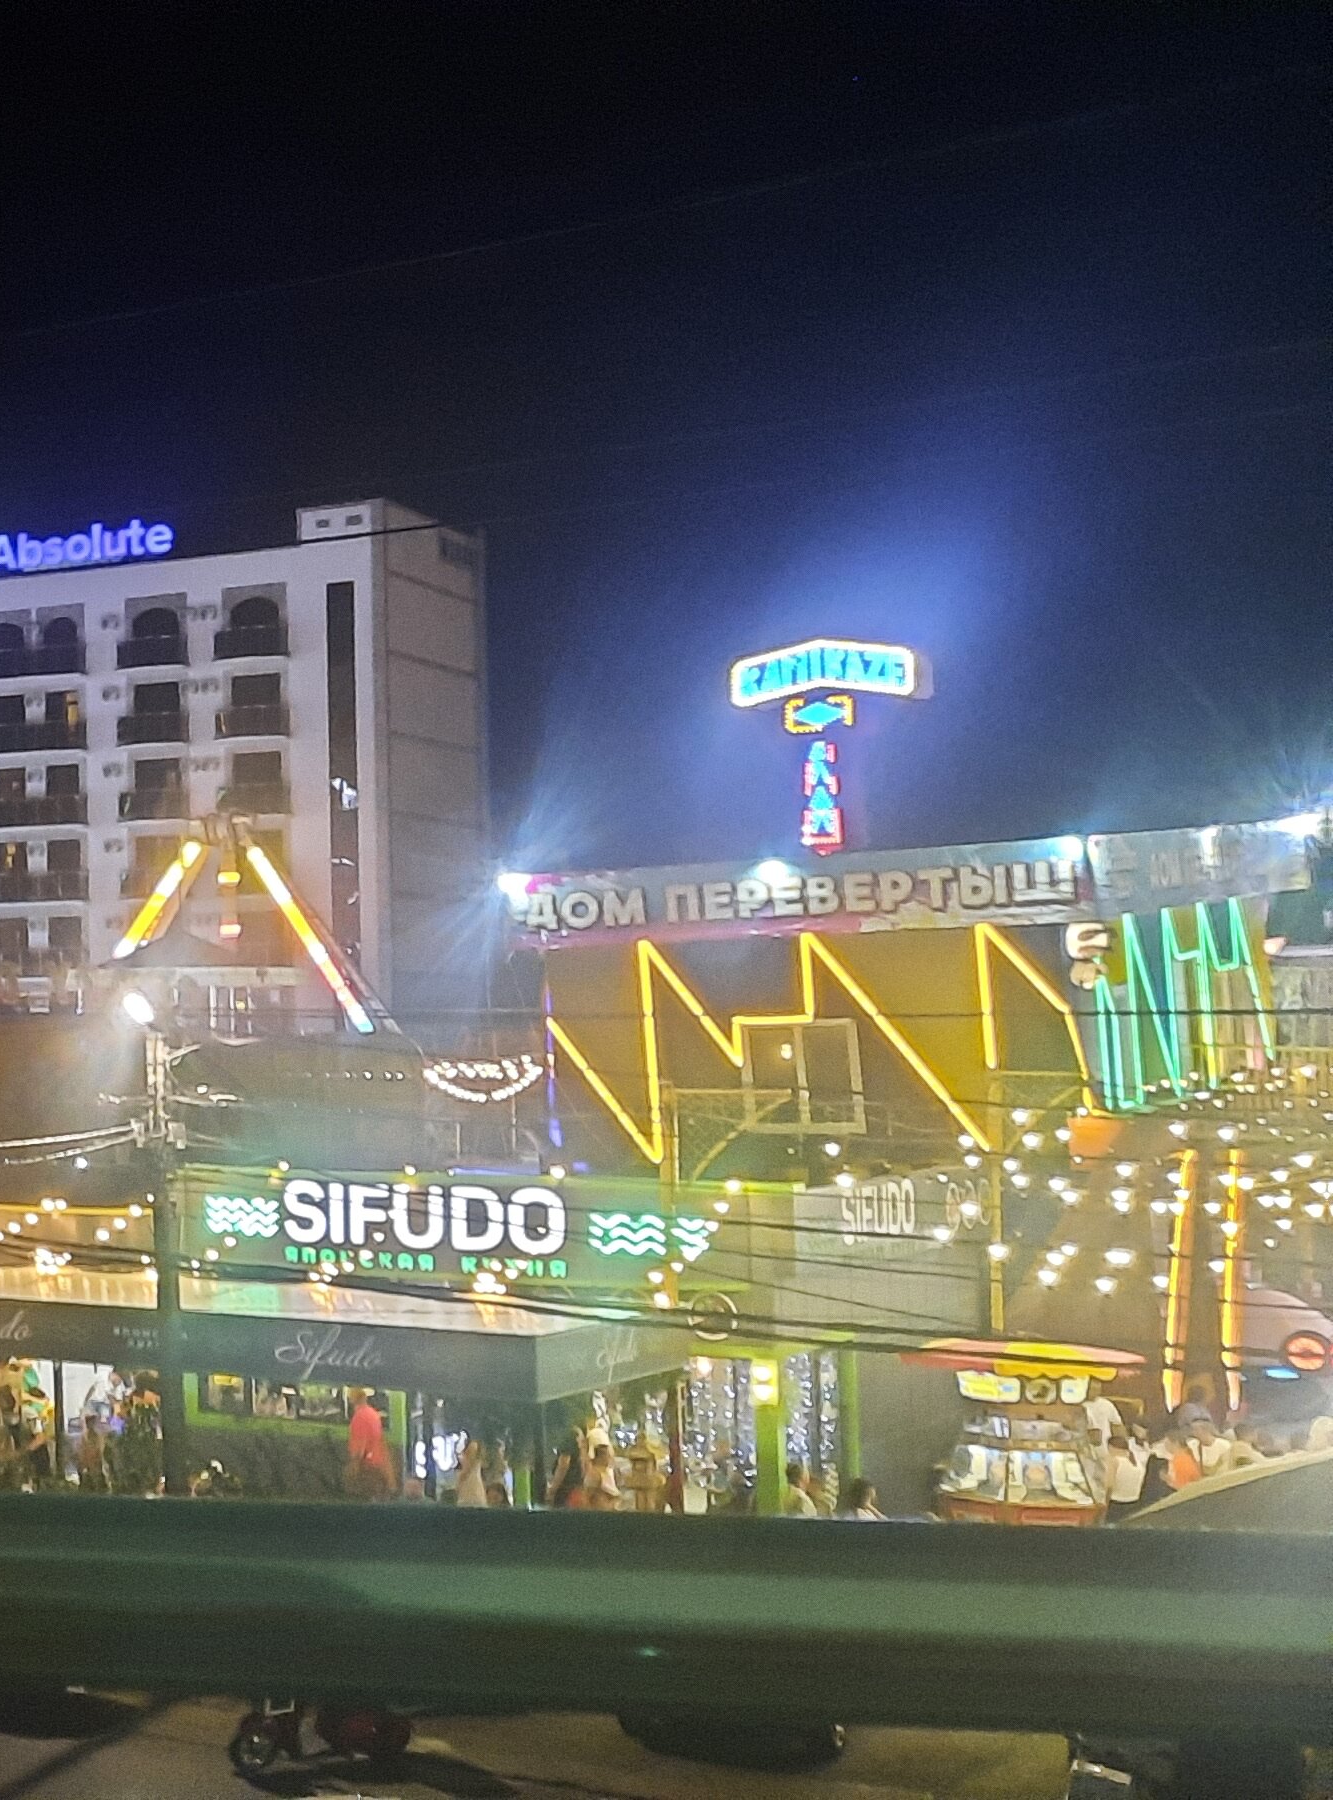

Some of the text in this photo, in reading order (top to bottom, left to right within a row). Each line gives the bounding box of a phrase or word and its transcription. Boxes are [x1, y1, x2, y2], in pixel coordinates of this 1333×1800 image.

[525, 858, 1079, 932] ДОМ ПЕРЕВЕРТЫШ
[283, 1178, 569, 1255] SIFUDO
[841, 1177, 916, 1246] SIFUDO
